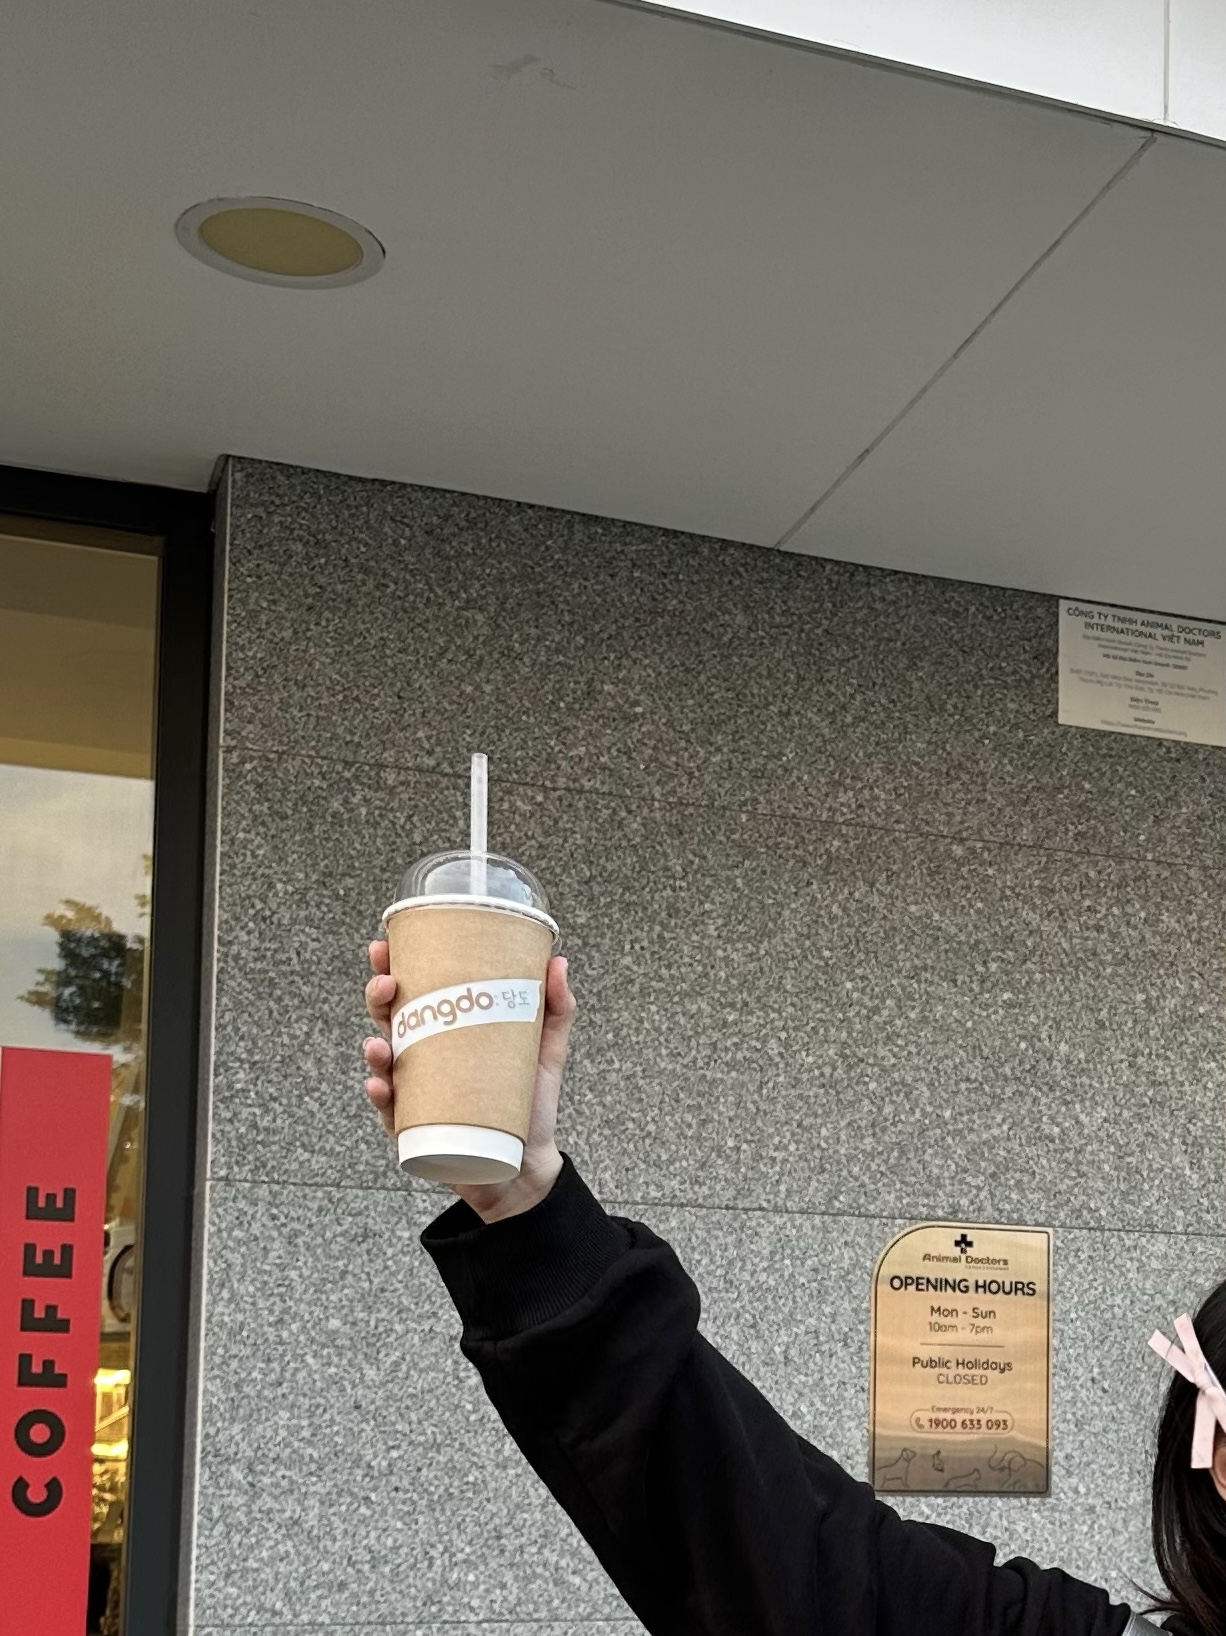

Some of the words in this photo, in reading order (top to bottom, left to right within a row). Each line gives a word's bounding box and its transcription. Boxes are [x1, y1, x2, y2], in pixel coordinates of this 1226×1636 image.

[1067, 607, 1095, 620] CÔNG
[1097, 611, 1109, 622] TY
[1140, 619, 1174, 632] ANIMAL
[1177, 625, 1222, 640] DOCTORS
[1084, 621, 1159, 642] INTERNATIONAL
[1184, 637, 1205, 648] NAM
[922, 1253, 962, 1265] Animal
[965, 1255, 1009, 1267] Doctors
[889, 1275, 970, 1294] OPENING
[975, 1279, 1037, 1297] HOURS
[930, 1305, 959, 1319] Mon
[972, 1307, 997, 1320] Sun
[928, 1321, 959, 1334] 10am
[969, 1323, 994, 1336] 7pm
[11, 1186, 77, 1518] COFFEE
[912, 1356, 953, 1370] Public
[955, 1358, 1013, 1374] Holidays
[936, 1373, 989, 1386] CLOSED
[931, 1405, 974, 1416] Emergency
[976, 1406, 994, 1415] 24/7
[928, 1417, 957, 1430] 1900
[961, 1419, 983, 1431] 633
[986, 1419, 1009, 1431] 093
